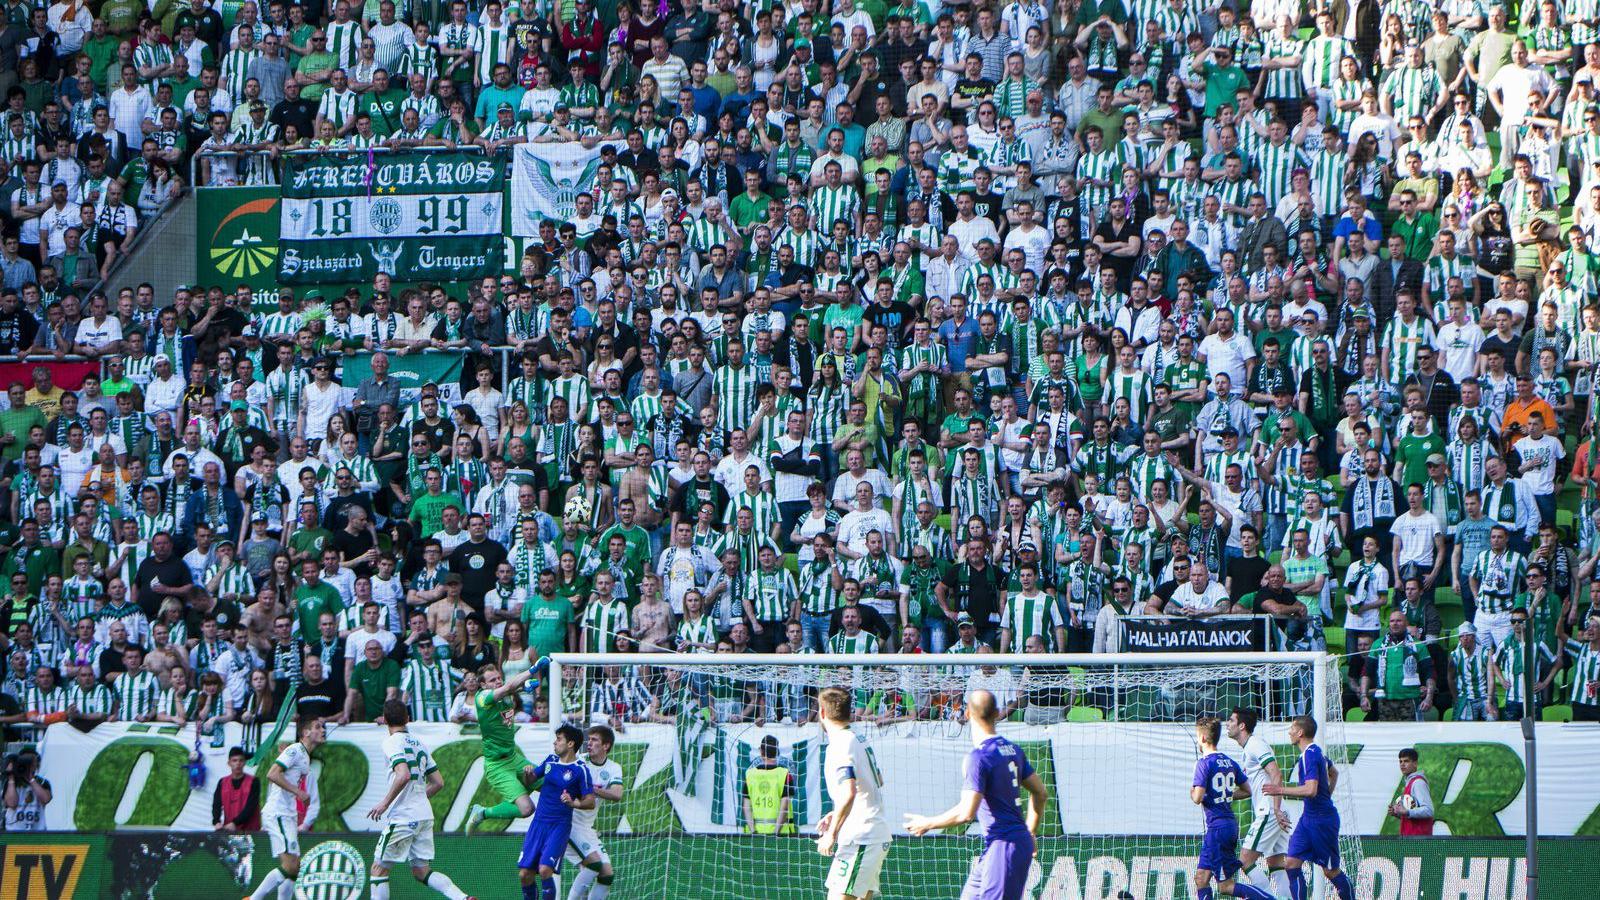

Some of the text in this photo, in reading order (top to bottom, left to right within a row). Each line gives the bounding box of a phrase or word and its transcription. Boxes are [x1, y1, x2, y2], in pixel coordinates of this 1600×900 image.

[312, 198, 352, 237] 18
[417, 195, 469, 234] 99
[281, 248, 363, 275] Szekszárd
[1129, 629, 1252, 647] HALHATATLANOK
[755, 797, 773, 808] 418
[1212, 771, 1236, 804] 99
[15, 854, 77, 900] TV
